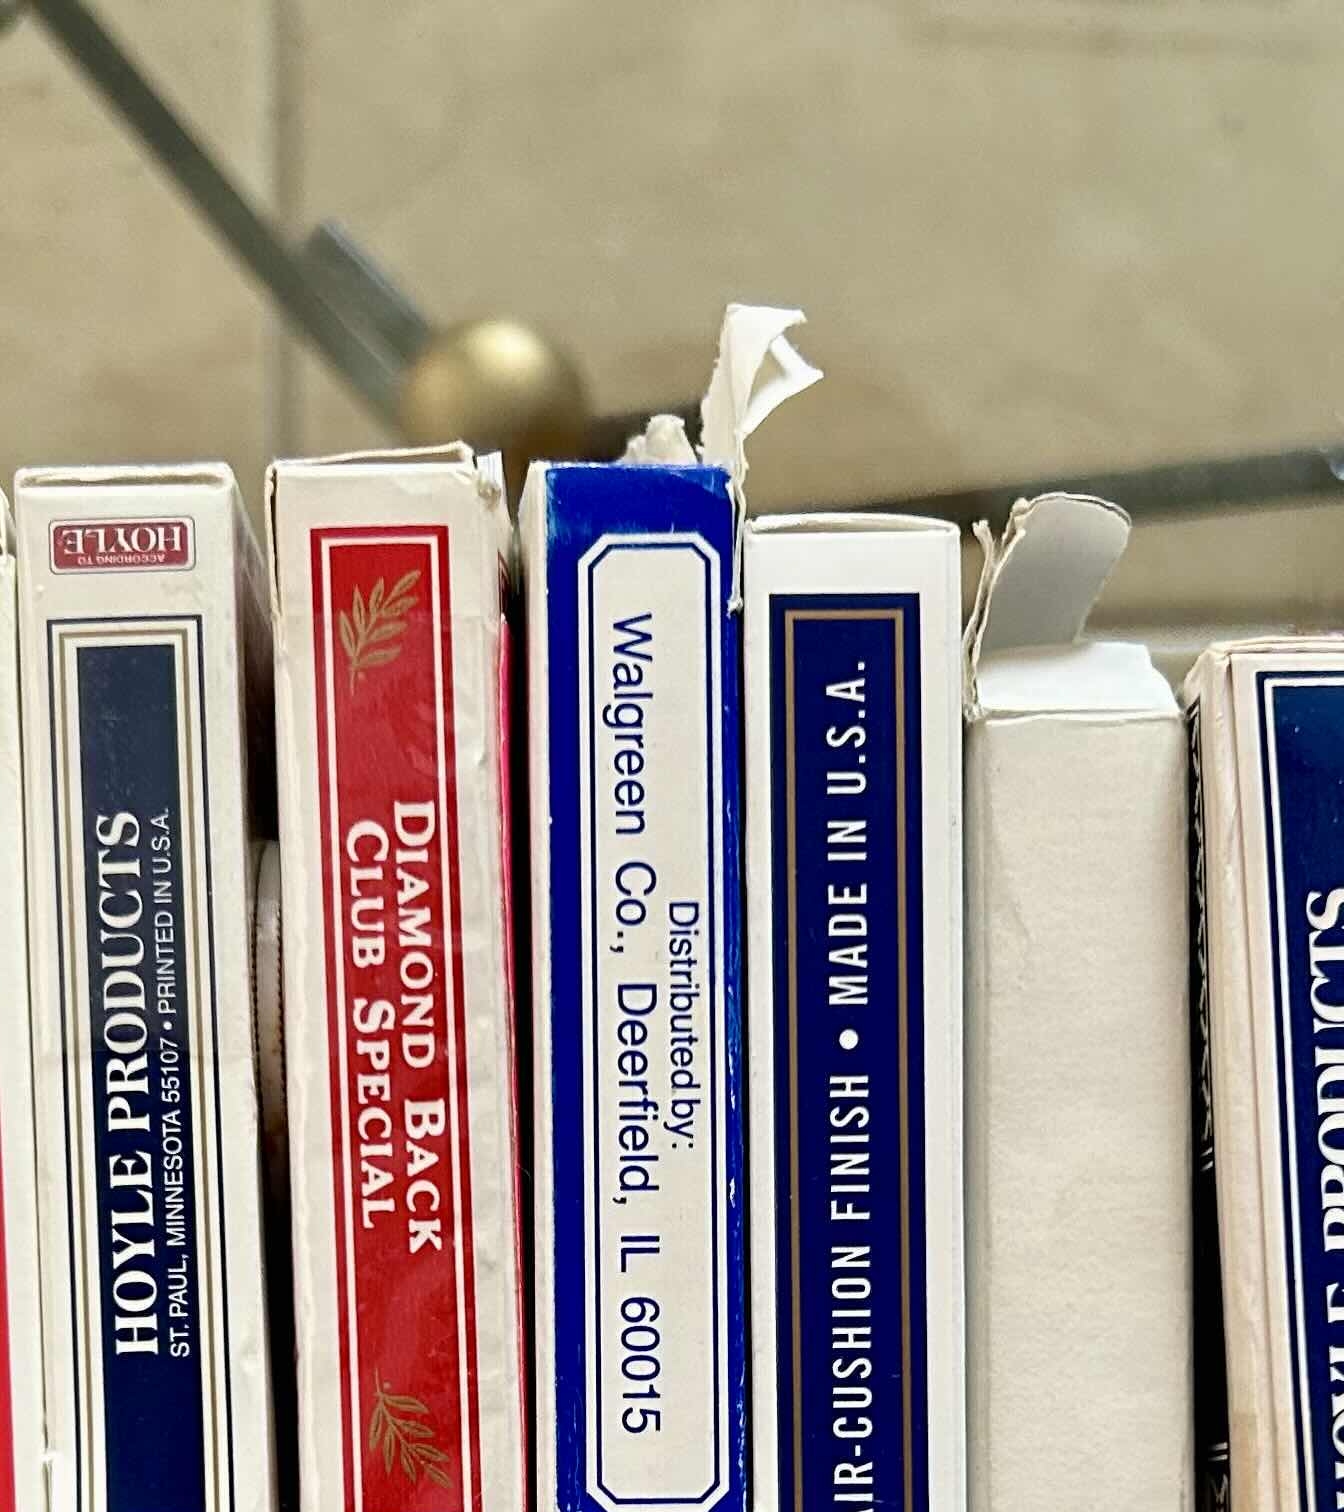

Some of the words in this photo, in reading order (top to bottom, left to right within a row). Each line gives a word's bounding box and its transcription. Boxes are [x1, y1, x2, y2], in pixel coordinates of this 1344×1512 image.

[61, 526, 182, 555] HOYLE
[77, 556, 93, 566] TO
[96, 553, 166, 565] ACCORDING
[602, 613, 654, 835] Walgreen
[826, 660, 867, 796] U.S.A.
[150, 808, 173, 873] U.S.A.
[154, 880, 173, 904] IN
[346, 820, 389, 968] CLUB
[827, 820, 867, 861] IN
[154, 910, 177, 1014] PRINTED
[393, 800, 436, 1068] DIAMOND
[609, 861, 657, 953] Co.,
[827, 883, 869, 1005] MADE
[96, 811, 151, 1133] PRODUCTS
[668, 901, 699, 1090] Distributed
[159, 1037, 181, 1103] 55107
[353, 997, 396, 1229] SPECIAL
[612, 983, 660, 1205] Deerfield,
[663, 1097, 701, 1150] by:
[160, 1110, 186, 1247] MINNESOTA
[404, 1098, 446, 1254] BACK
[829, 1075, 871, 1221] FINISH
[108, 1150, 159, 1355] HOYLE
[167, 1253, 189, 1317] PAUL,
[620, 1235, 661, 1273] IL
[169, 1324, 191, 1358] ST.
[620, 1296, 661, 1434] 60015
